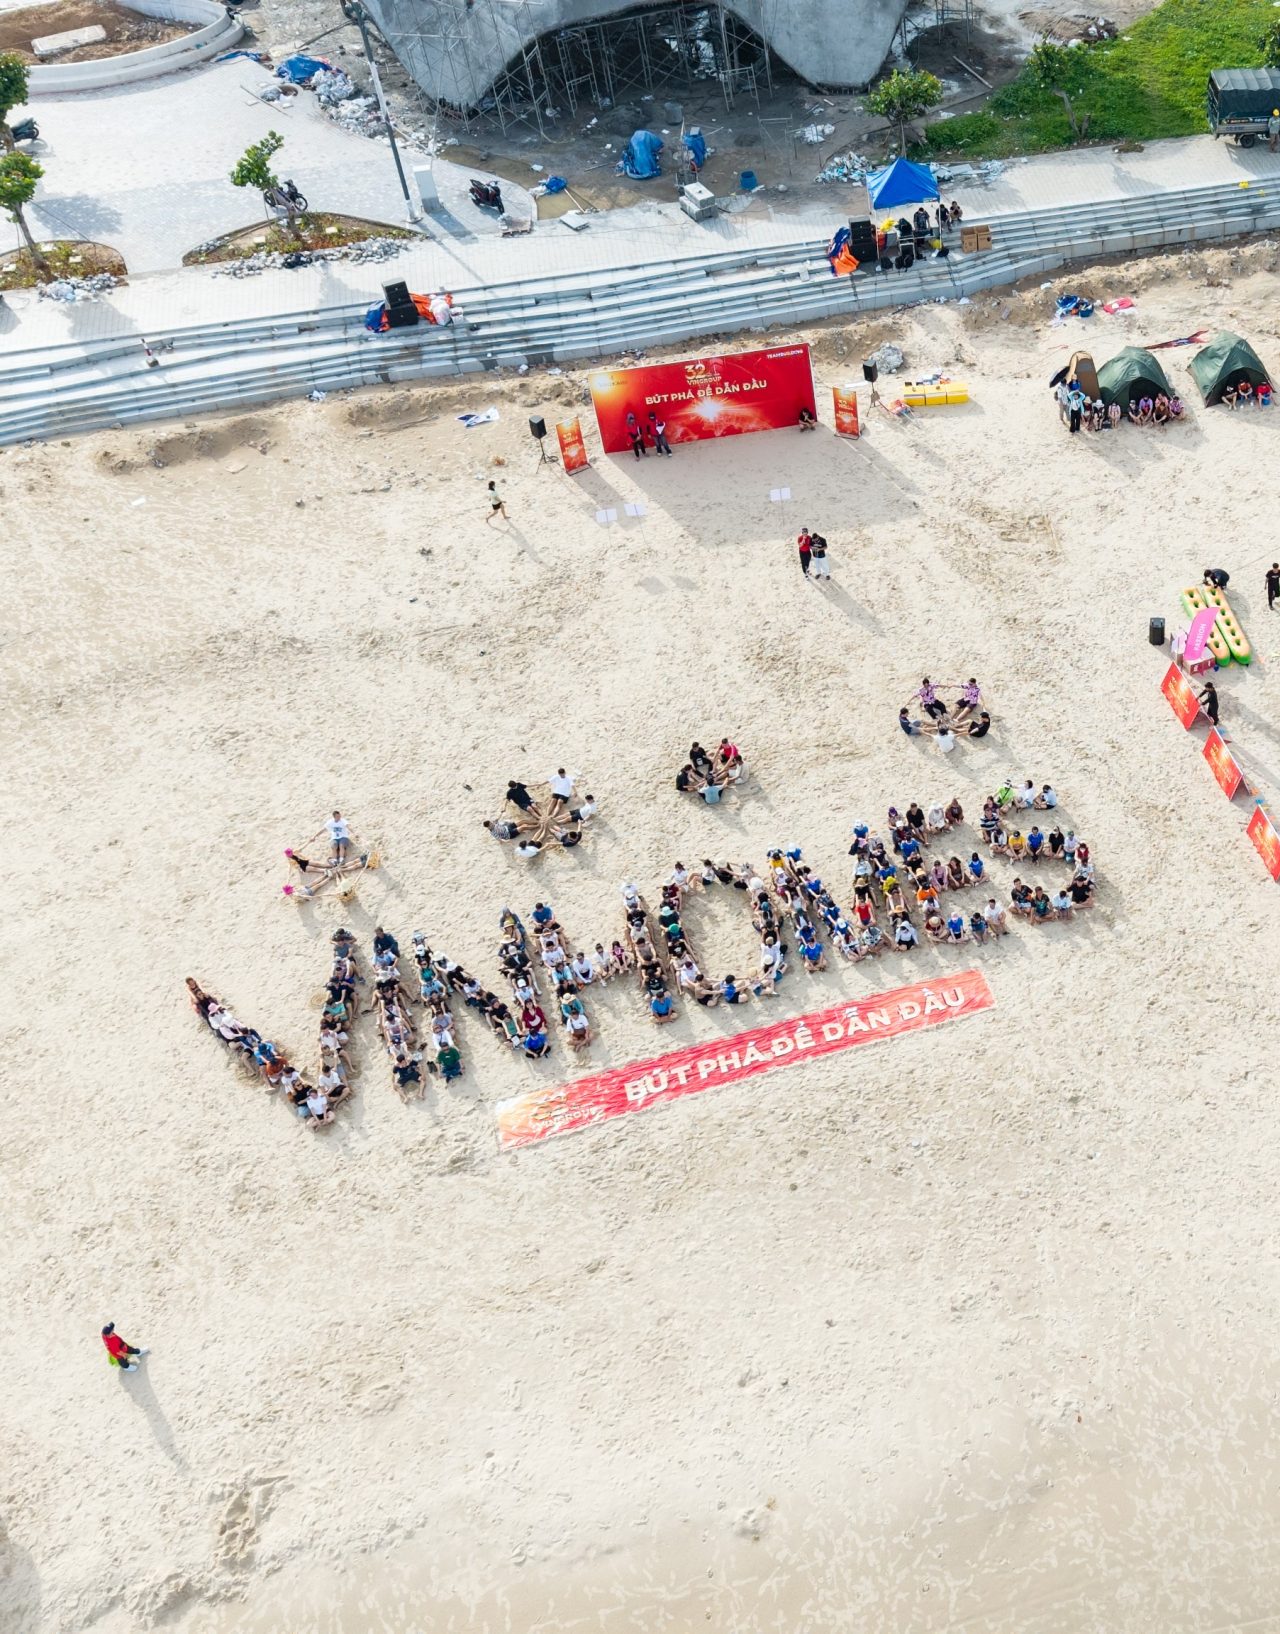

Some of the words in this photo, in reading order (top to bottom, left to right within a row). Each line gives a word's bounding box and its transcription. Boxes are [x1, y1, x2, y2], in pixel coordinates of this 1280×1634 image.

[684, 363, 708, 380] 32
[687, 376, 722, 386] VINGROUP
[670, 389, 695, 401] PHÁ
[715, 381, 740, 395] DẪN
[742, 377, 767, 391] ĐẦU
[697, 1040, 765, 1080] PHÁ
[822, 1006, 892, 1042] DẪN
[897, 987, 966, 1021] ĐẦU
